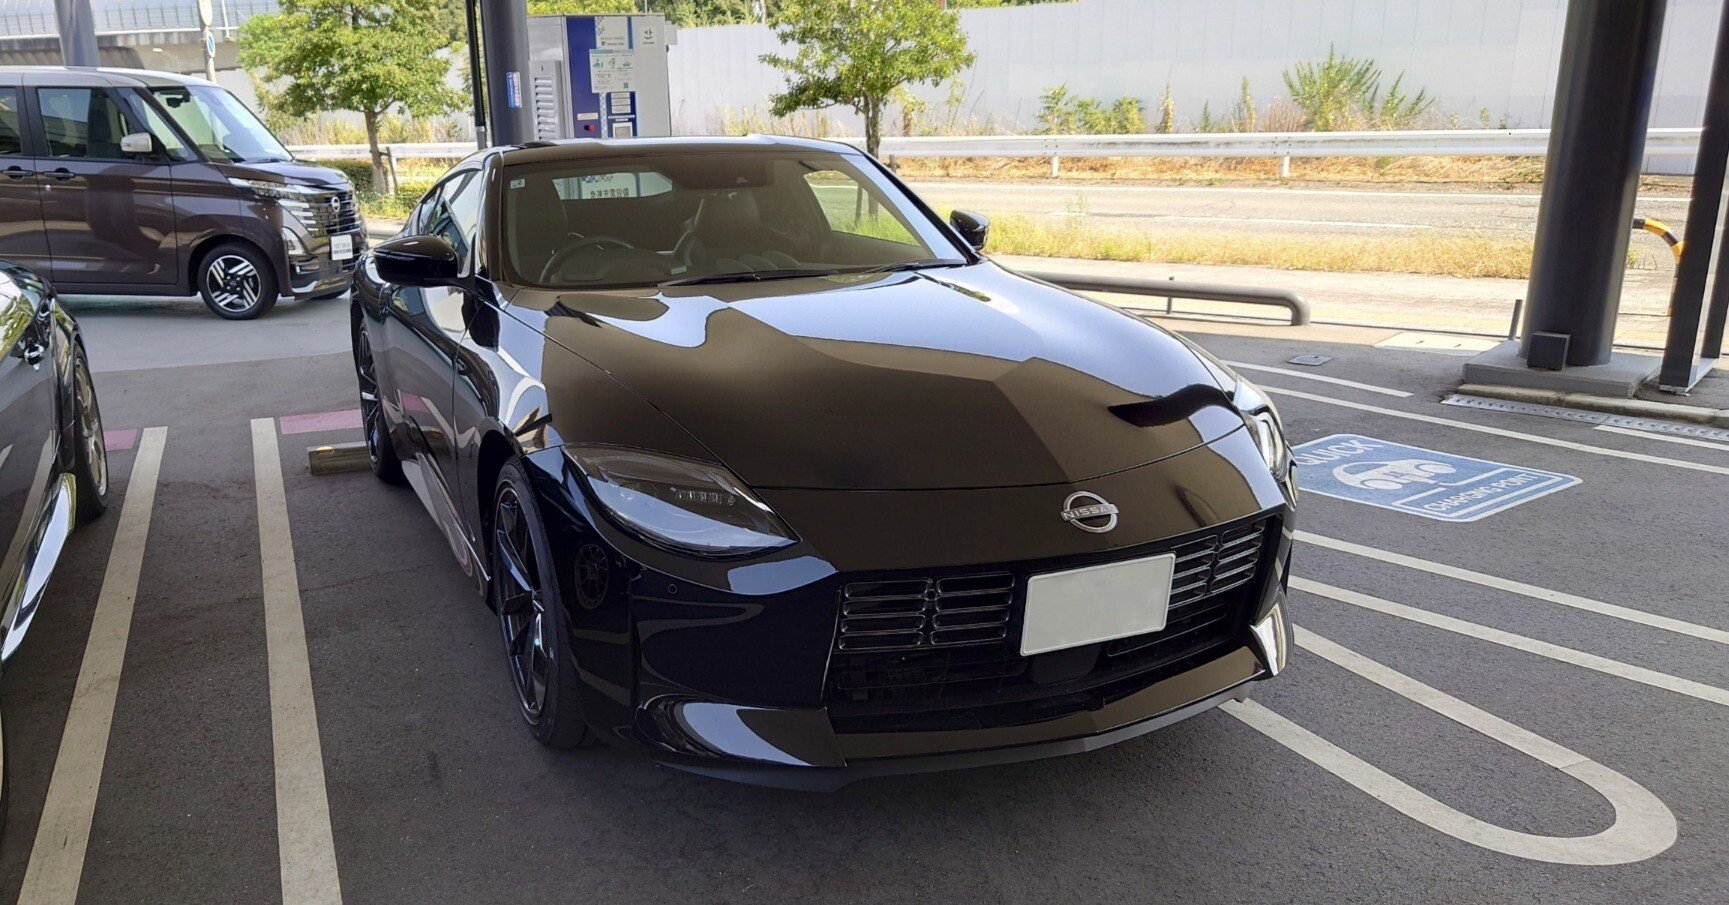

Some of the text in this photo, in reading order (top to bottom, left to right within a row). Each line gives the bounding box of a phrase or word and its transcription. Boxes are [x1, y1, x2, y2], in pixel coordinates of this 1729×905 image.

[1294, 440, 1383, 465] QUICK
[1491, 474, 1538, 492] POINT
[1063, 506, 1114, 519] NISSAN
